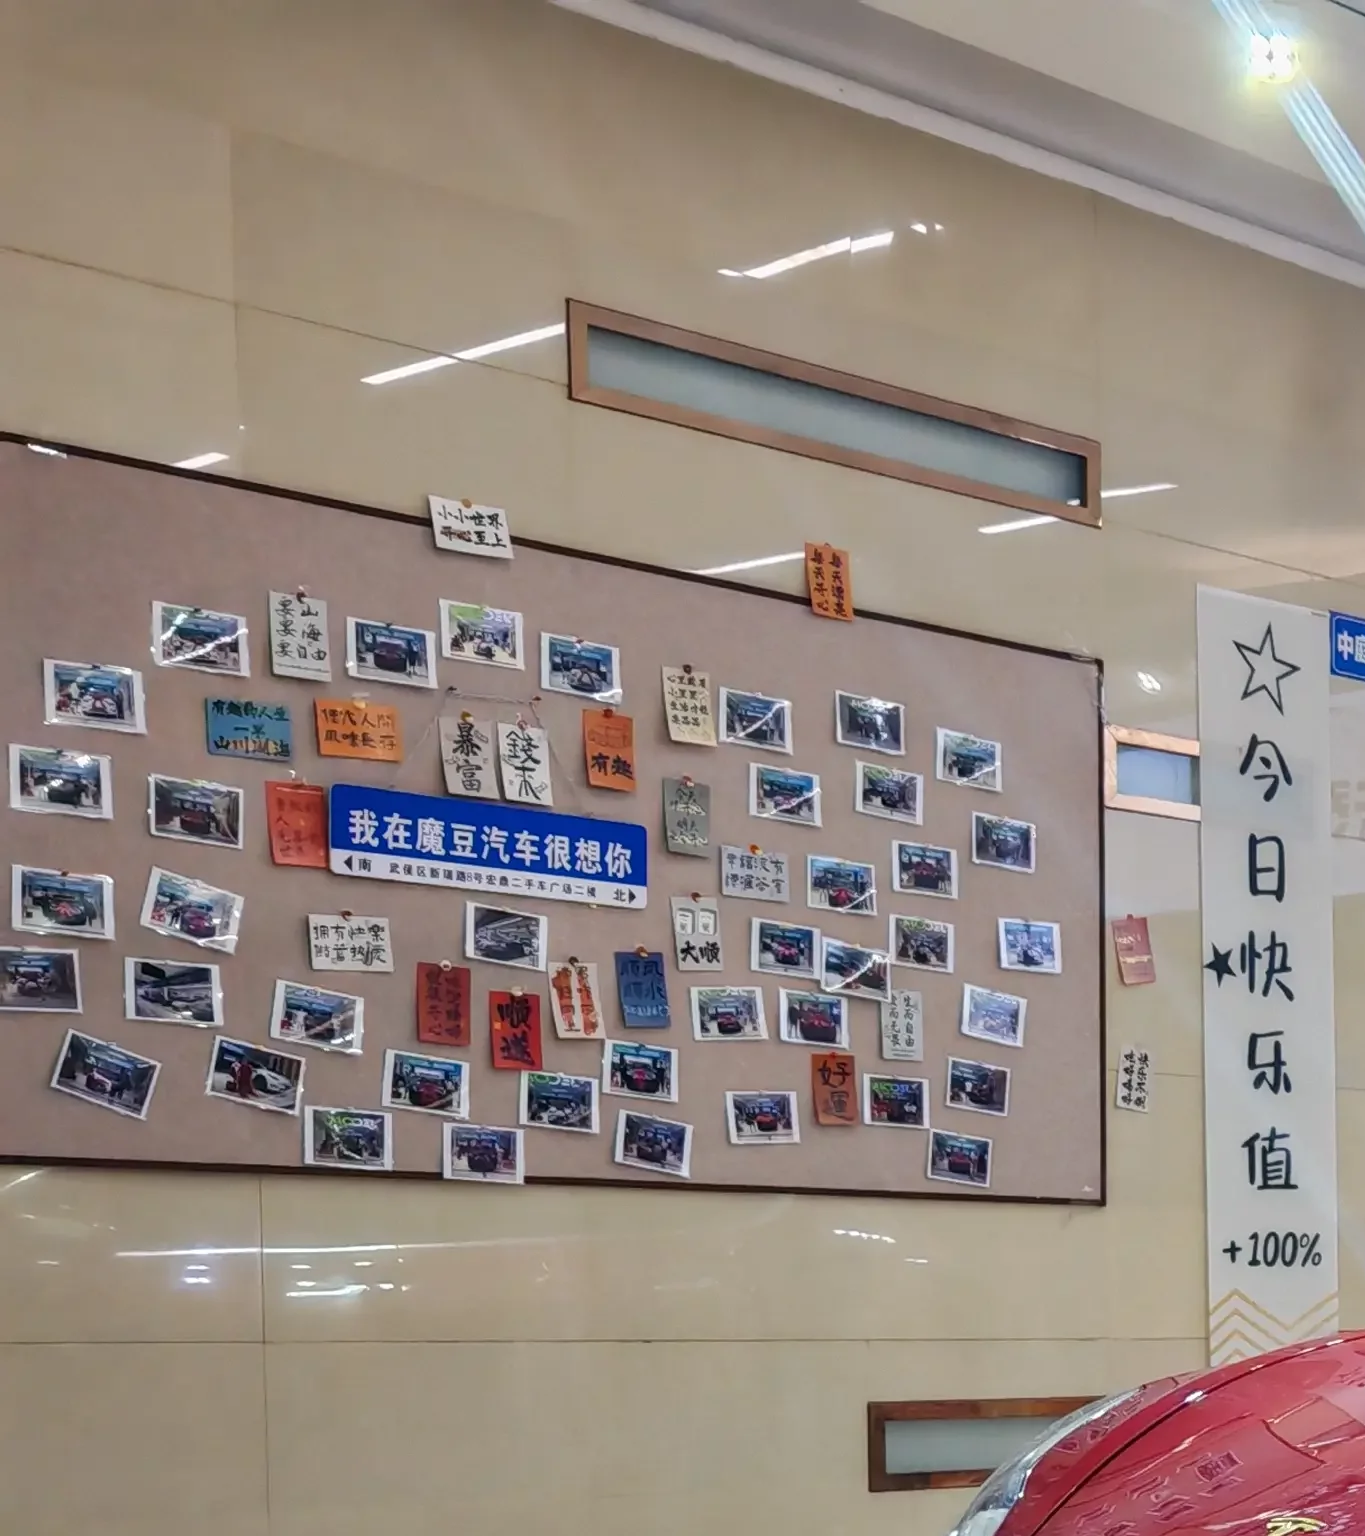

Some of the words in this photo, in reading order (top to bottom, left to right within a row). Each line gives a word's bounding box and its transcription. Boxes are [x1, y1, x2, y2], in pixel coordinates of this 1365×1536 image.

[348, 808, 633, 880] 我在魔豆汽车很想你
[357, 858, 372, 873] 南
[613, 888, 627, 902] 北
[1239, 733, 1300, 1193] 今日快乐值
[1222, 1230, 1323, 1269] +100%
